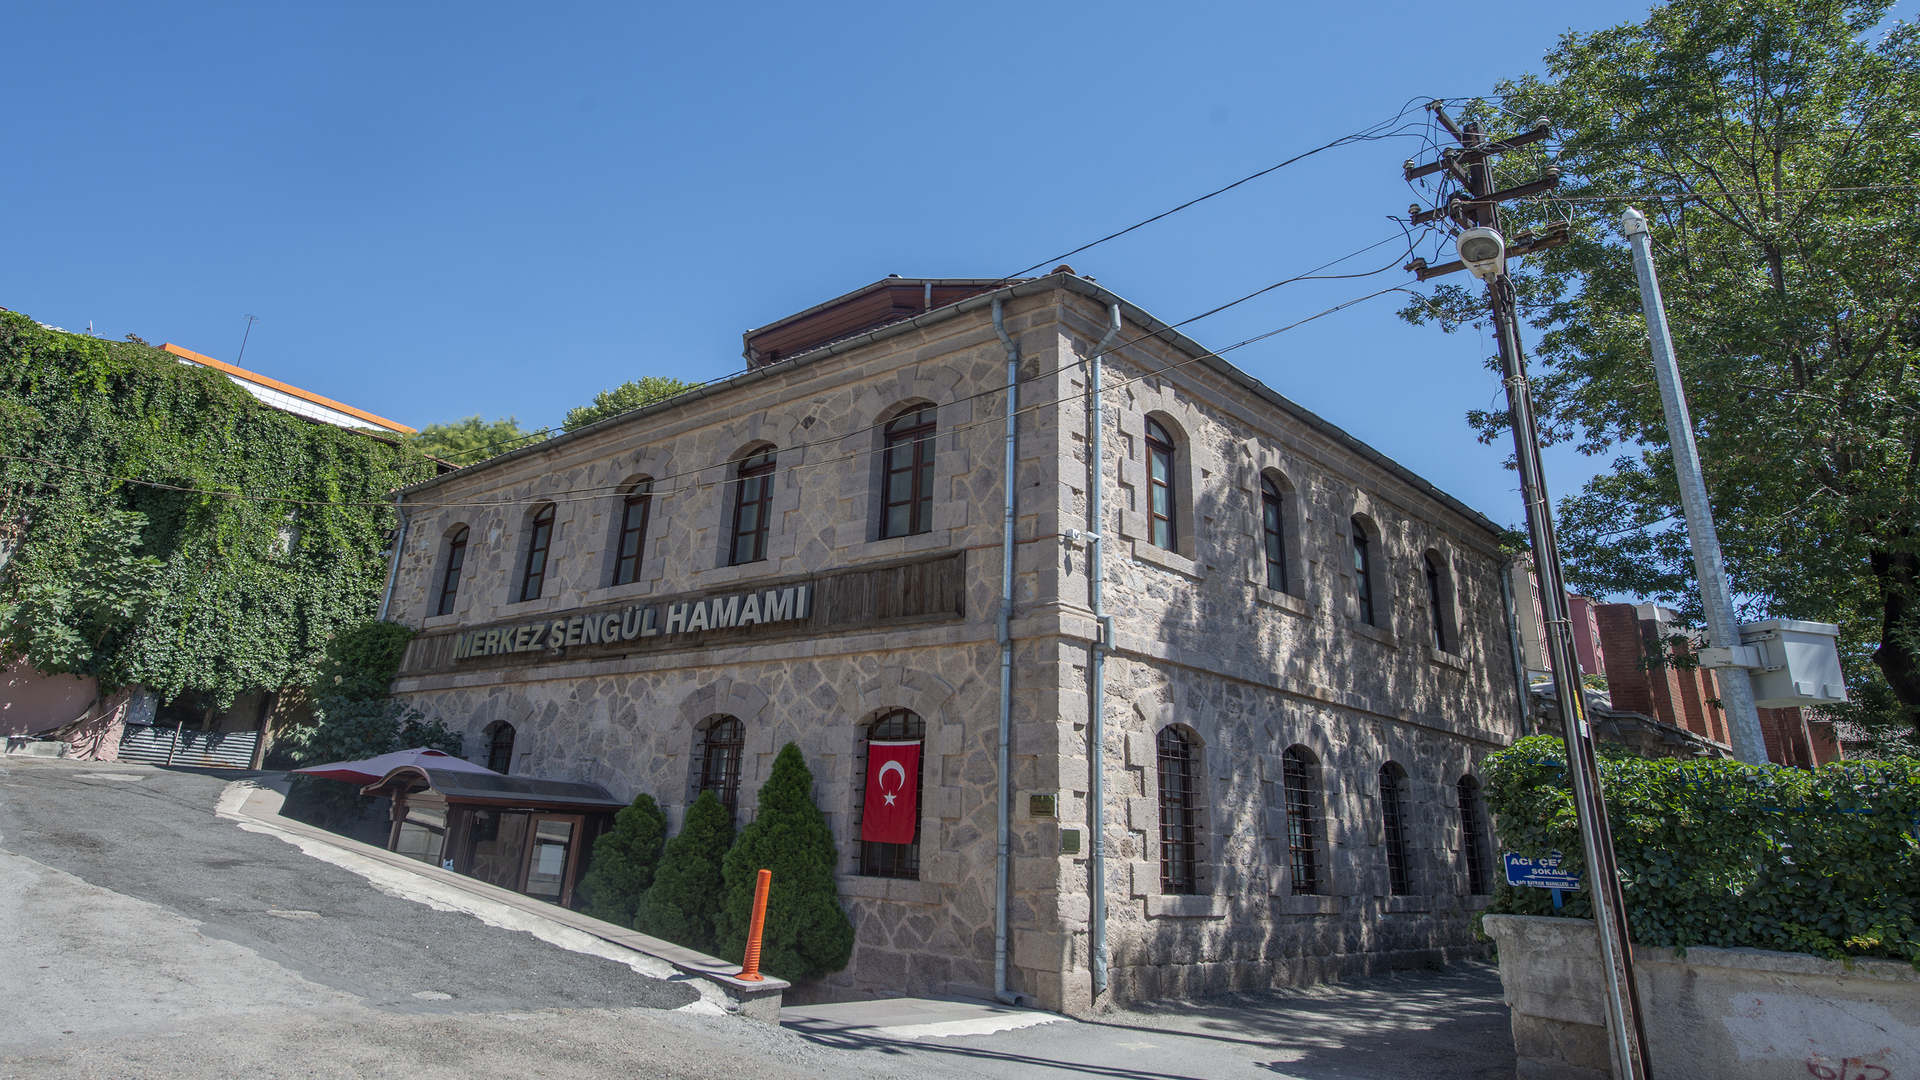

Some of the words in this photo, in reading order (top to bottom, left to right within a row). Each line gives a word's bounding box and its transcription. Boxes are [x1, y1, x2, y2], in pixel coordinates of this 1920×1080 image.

[452, 624, 546, 659] MERKEZ
[548, 604, 658, 656] ŞENGÜL
[665, 585, 808, 635] HAMAMI
[1510, 857, 1533, 866] ACI
